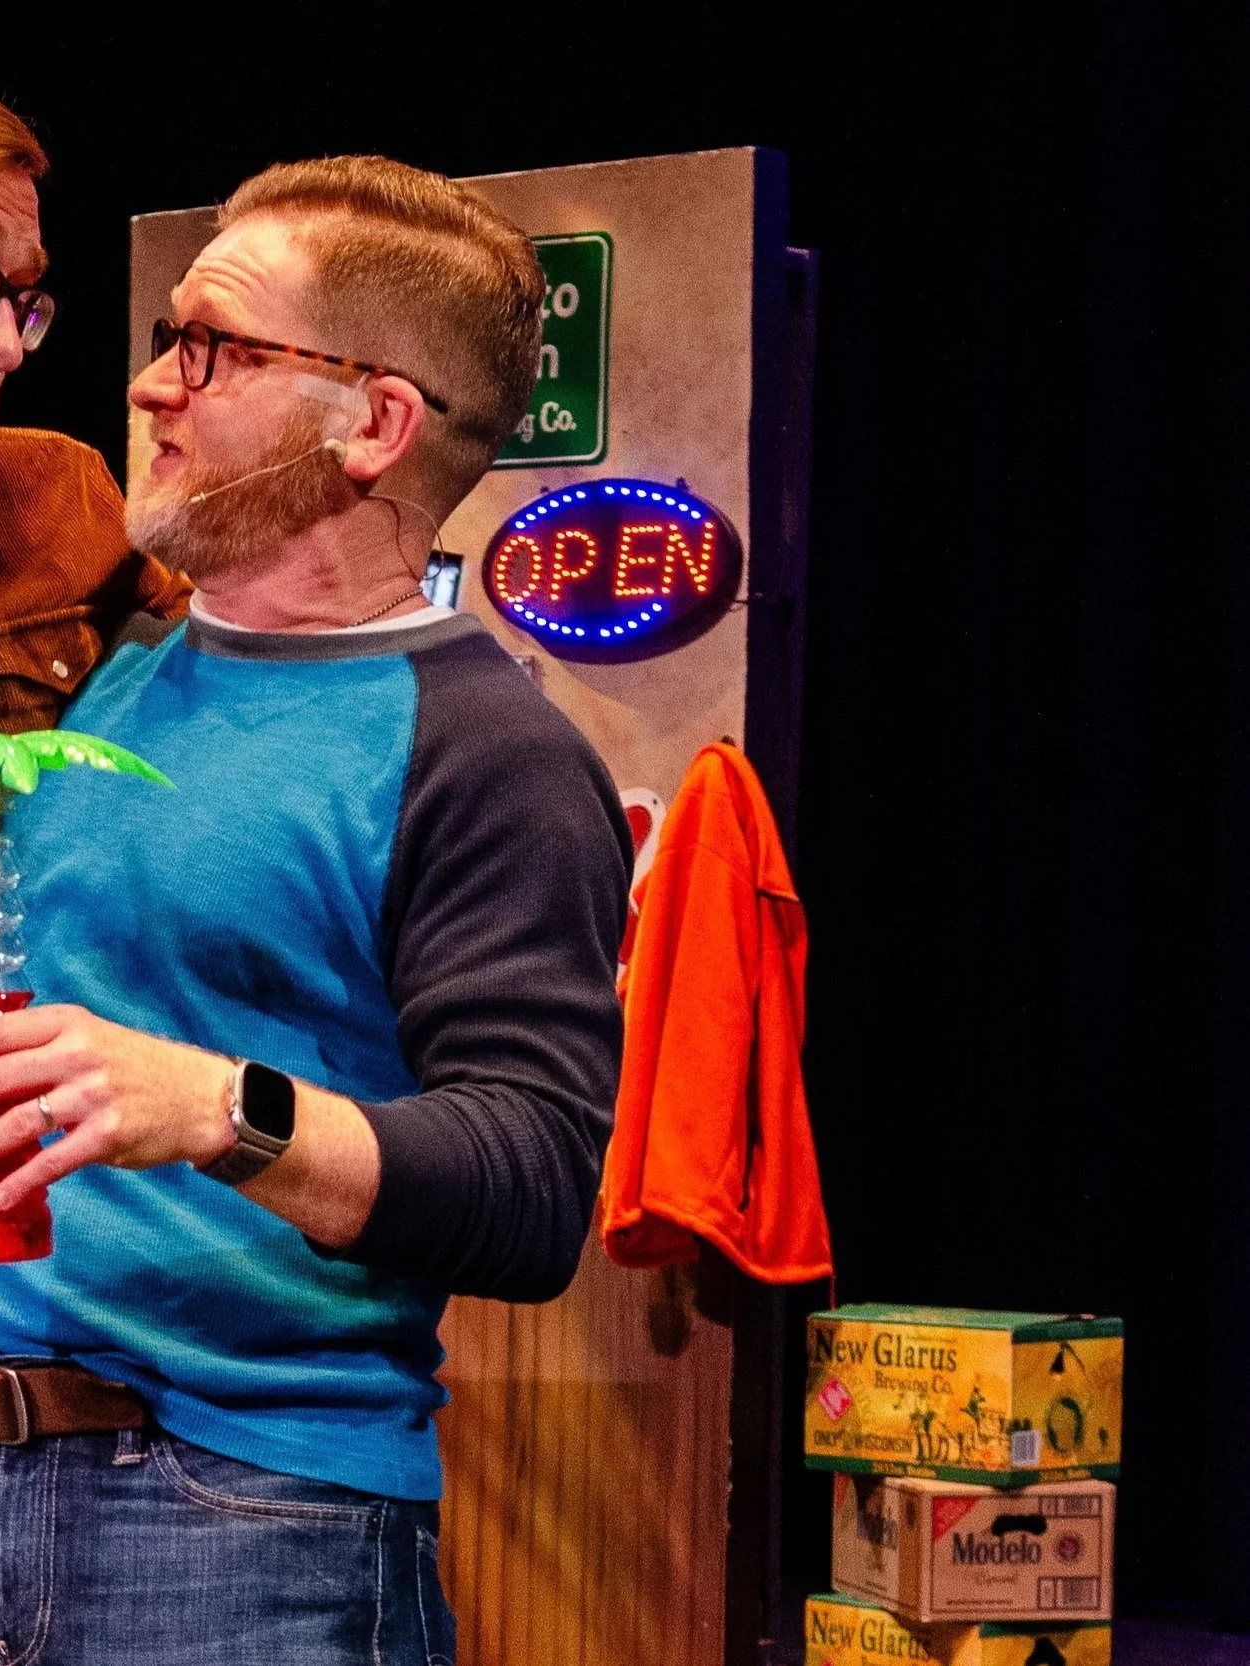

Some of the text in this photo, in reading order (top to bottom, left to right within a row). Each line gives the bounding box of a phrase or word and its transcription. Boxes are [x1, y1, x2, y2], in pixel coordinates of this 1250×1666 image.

[540, 401, 577, 432] Co.
[495, 520, 715, 602] OPEN
[814, 1329, 958, 1373] New Glarus
[952, 1531, 1042, 1566] Modelo
[810, 1610, 856, 1647] New
